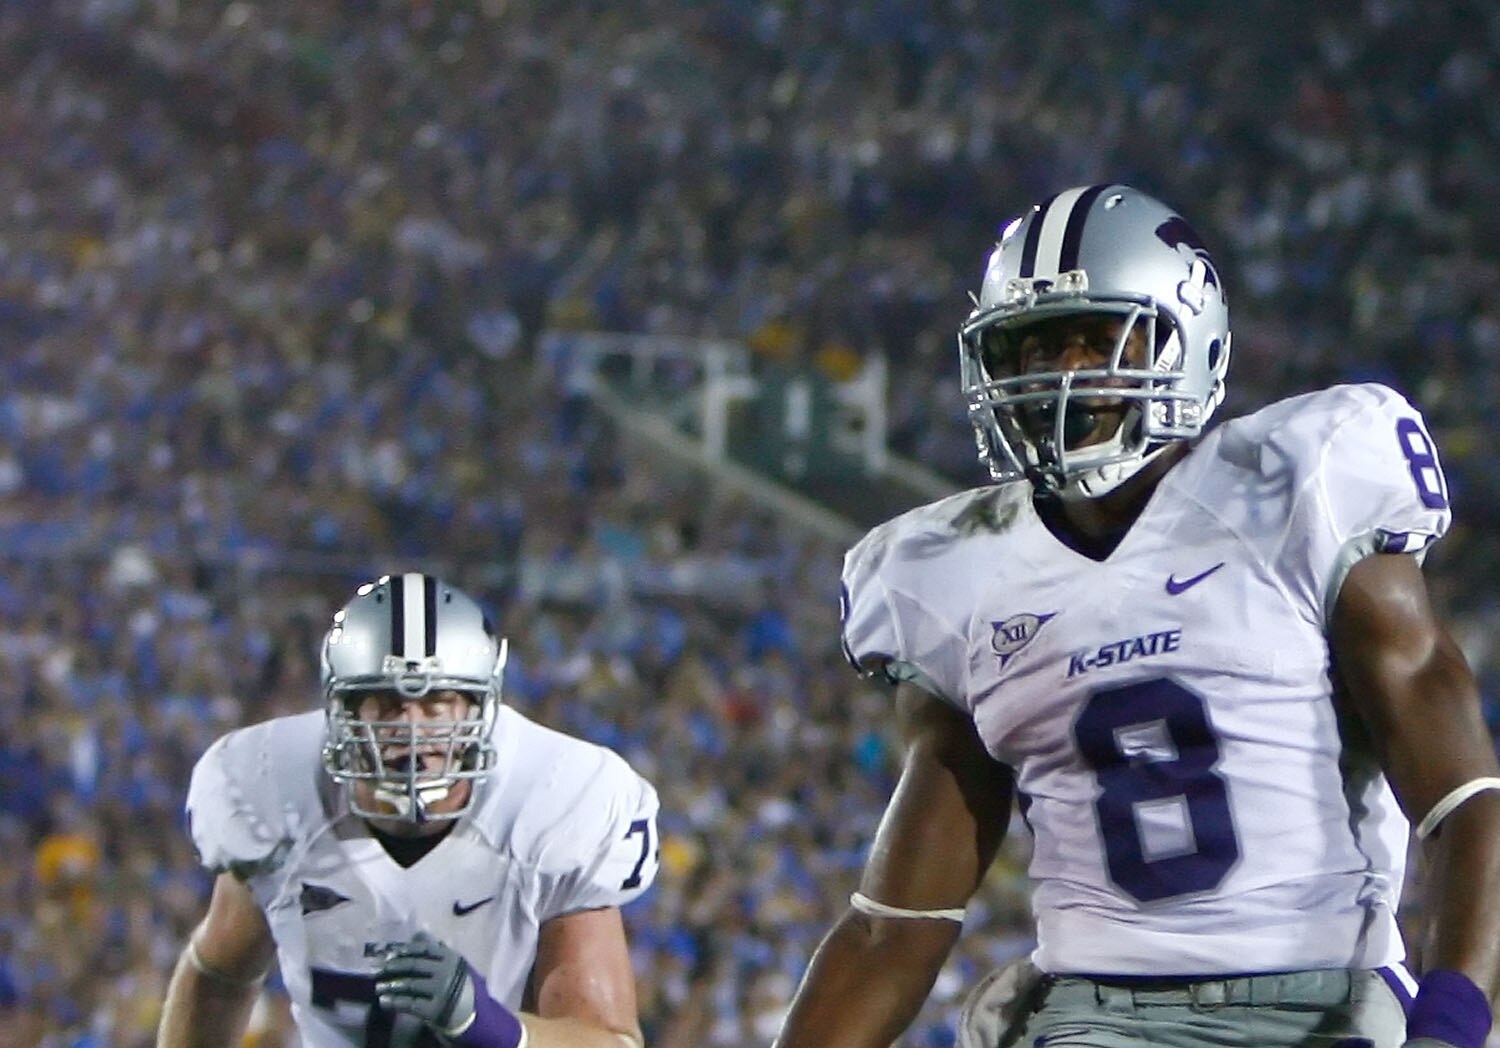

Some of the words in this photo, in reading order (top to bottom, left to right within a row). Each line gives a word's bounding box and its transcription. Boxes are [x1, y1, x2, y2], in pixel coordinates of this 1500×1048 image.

[1396, 417, 1447, 509] 8
[1001, 625, 1027, 645] XII
[1066, 629, 1182, 677] K-STATE
[1073, 677, 1241, 902] 8
[620, 818, 659, 889] 7
